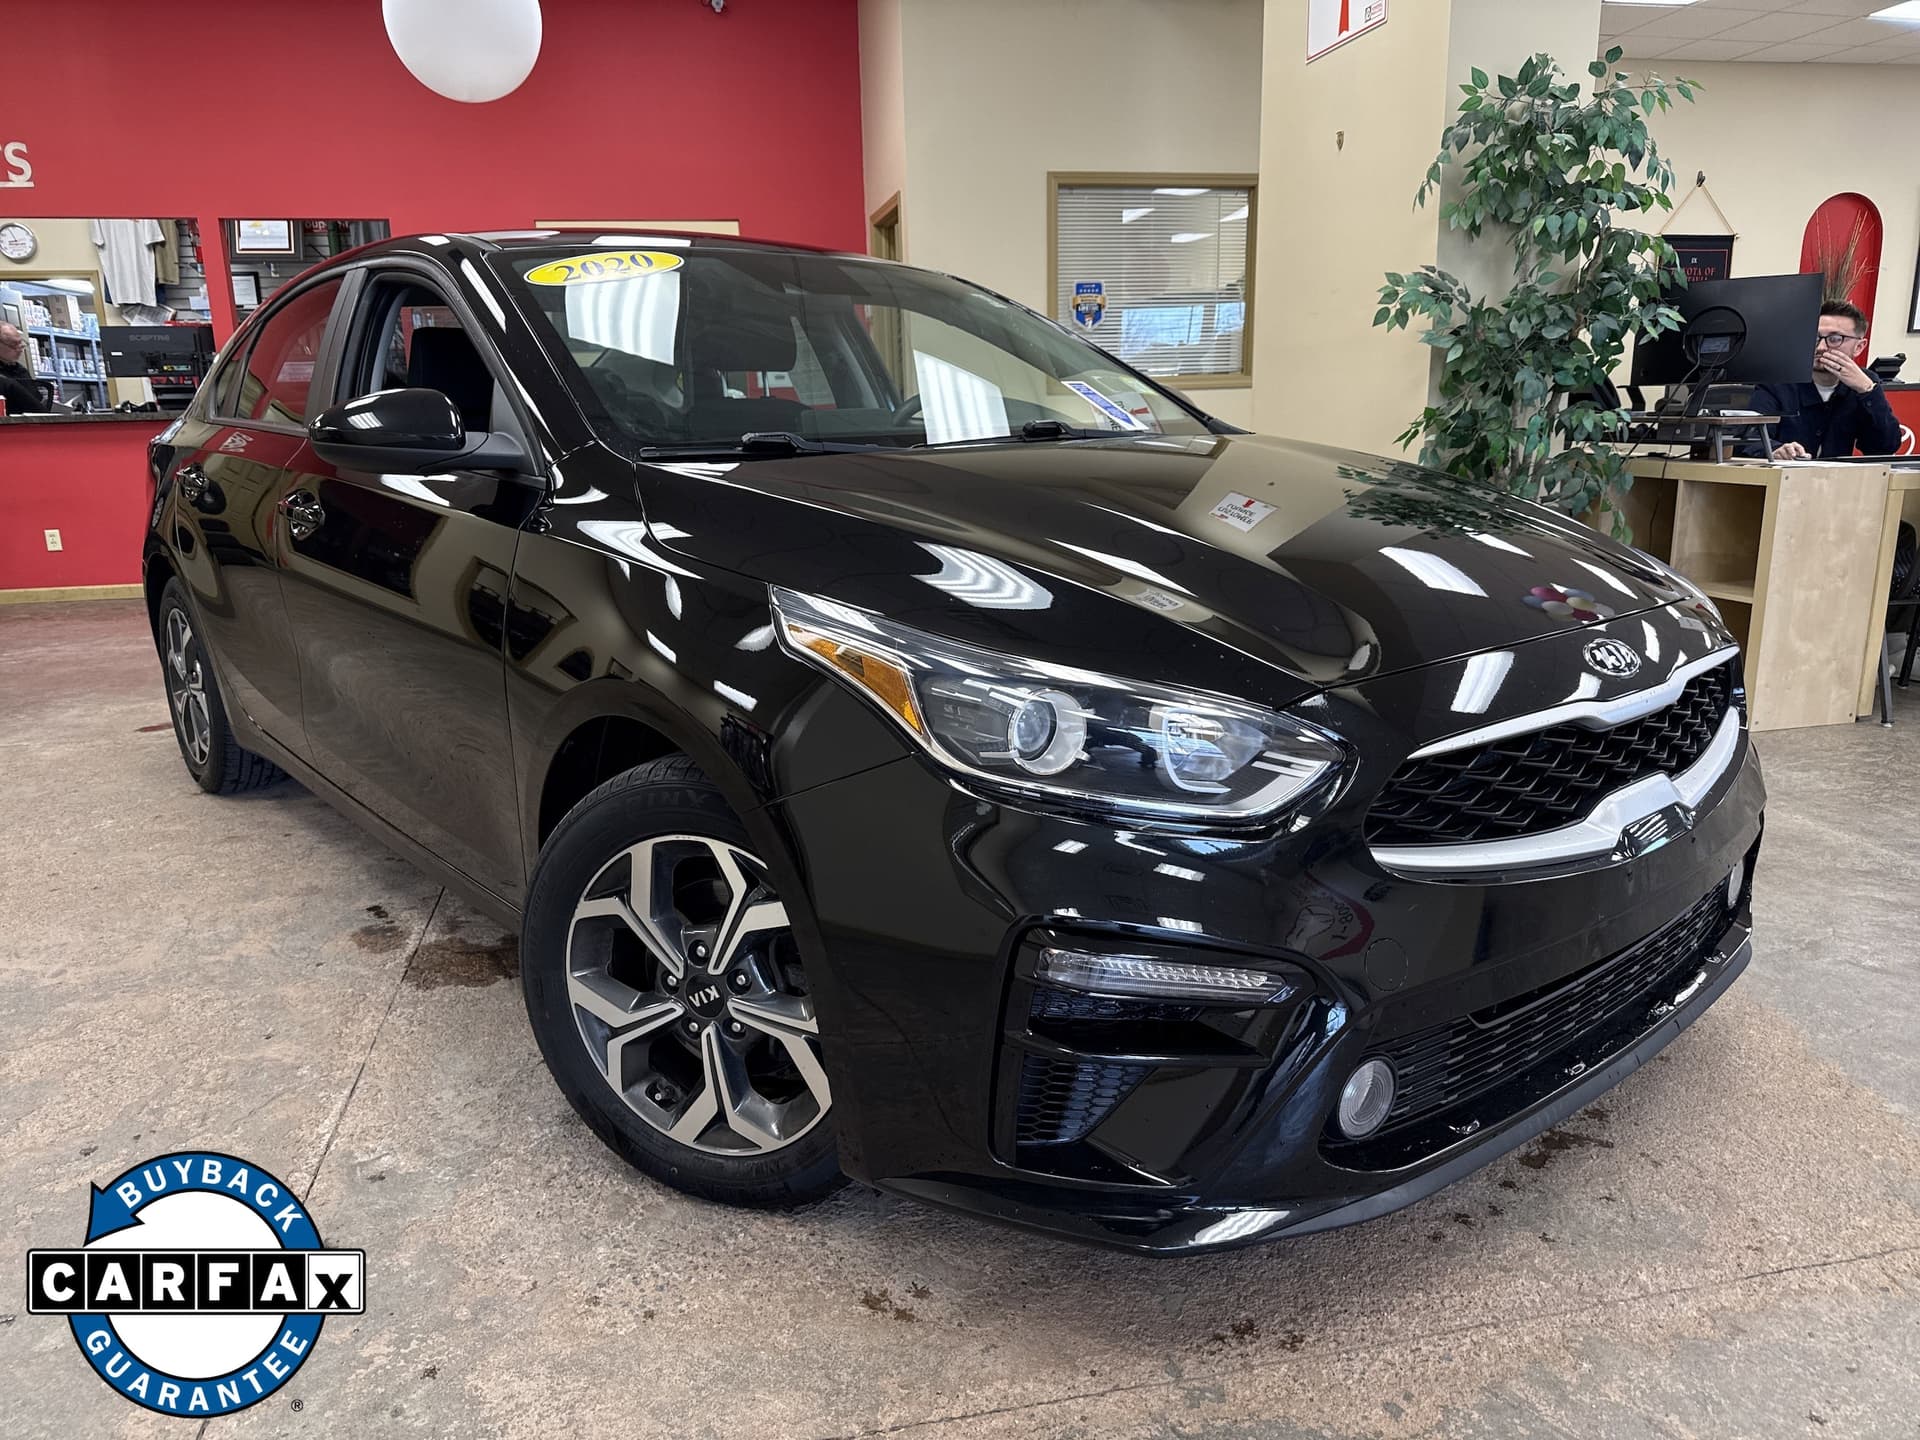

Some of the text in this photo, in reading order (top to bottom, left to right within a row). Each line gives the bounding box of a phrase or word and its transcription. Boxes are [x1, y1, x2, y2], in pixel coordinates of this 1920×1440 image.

[0, 142, 32, 182] S
[554, 253, 653, 282] 2020
[689, 985, 720, 1007] KIA
